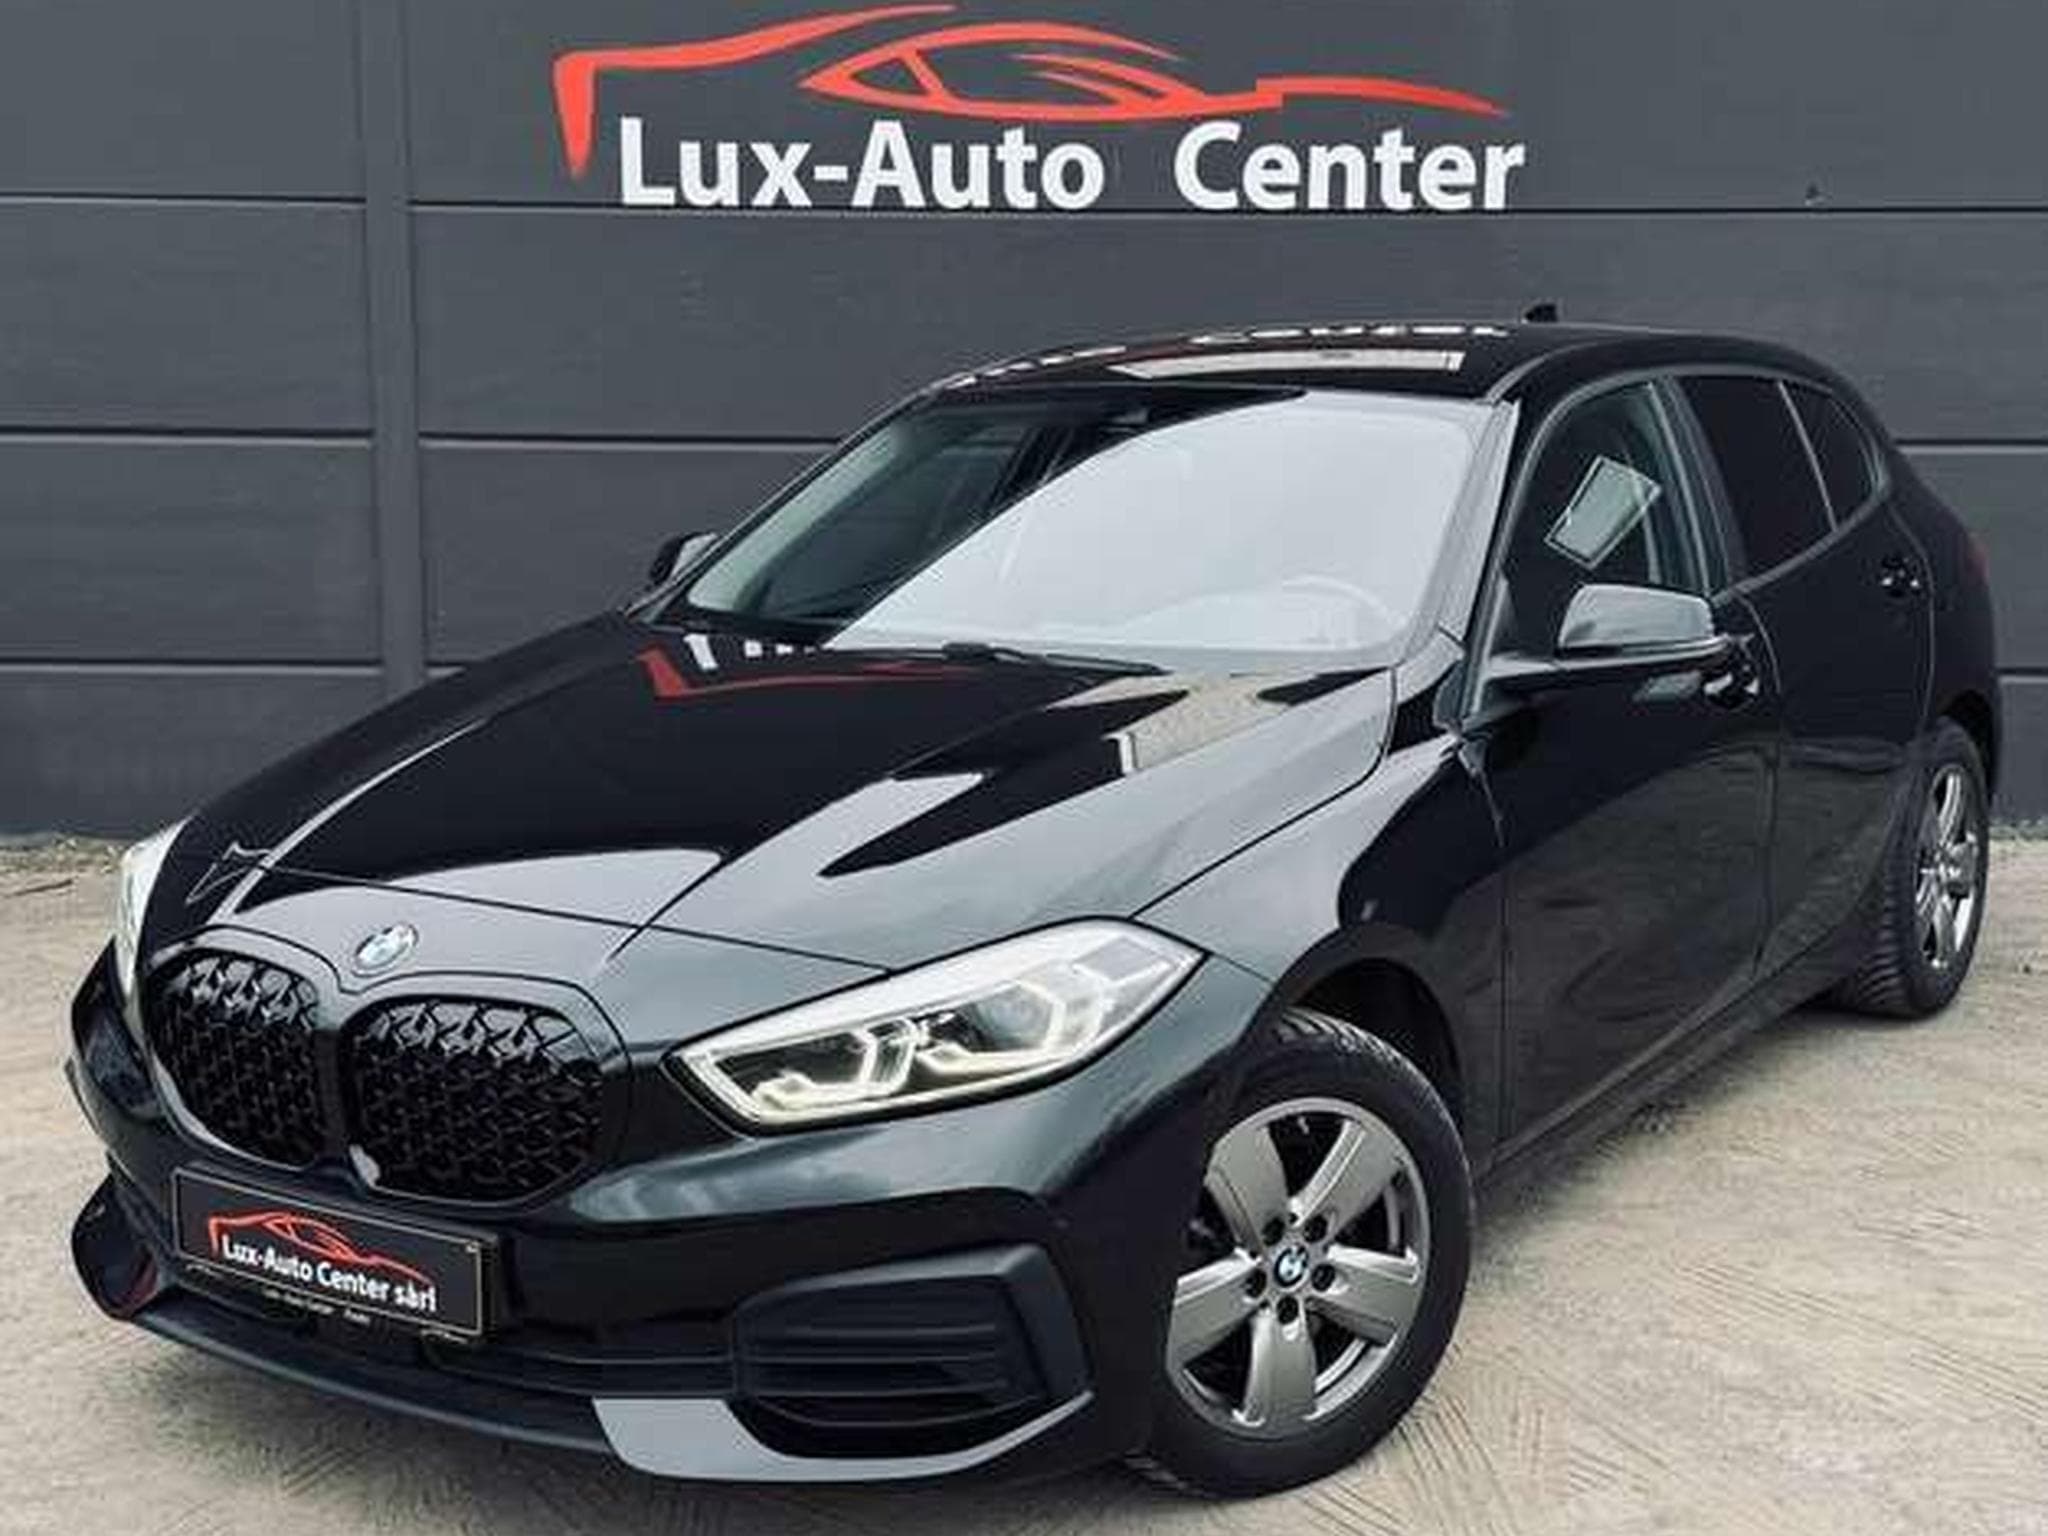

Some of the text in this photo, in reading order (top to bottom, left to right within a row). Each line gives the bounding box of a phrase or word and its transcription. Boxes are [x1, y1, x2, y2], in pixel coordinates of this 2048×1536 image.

[620, 116, 1526, 212] Lux-Auto Center
[222, 1233, 313, 1282] Lux-Auto
[316, 1261, 390, 1302] Center
